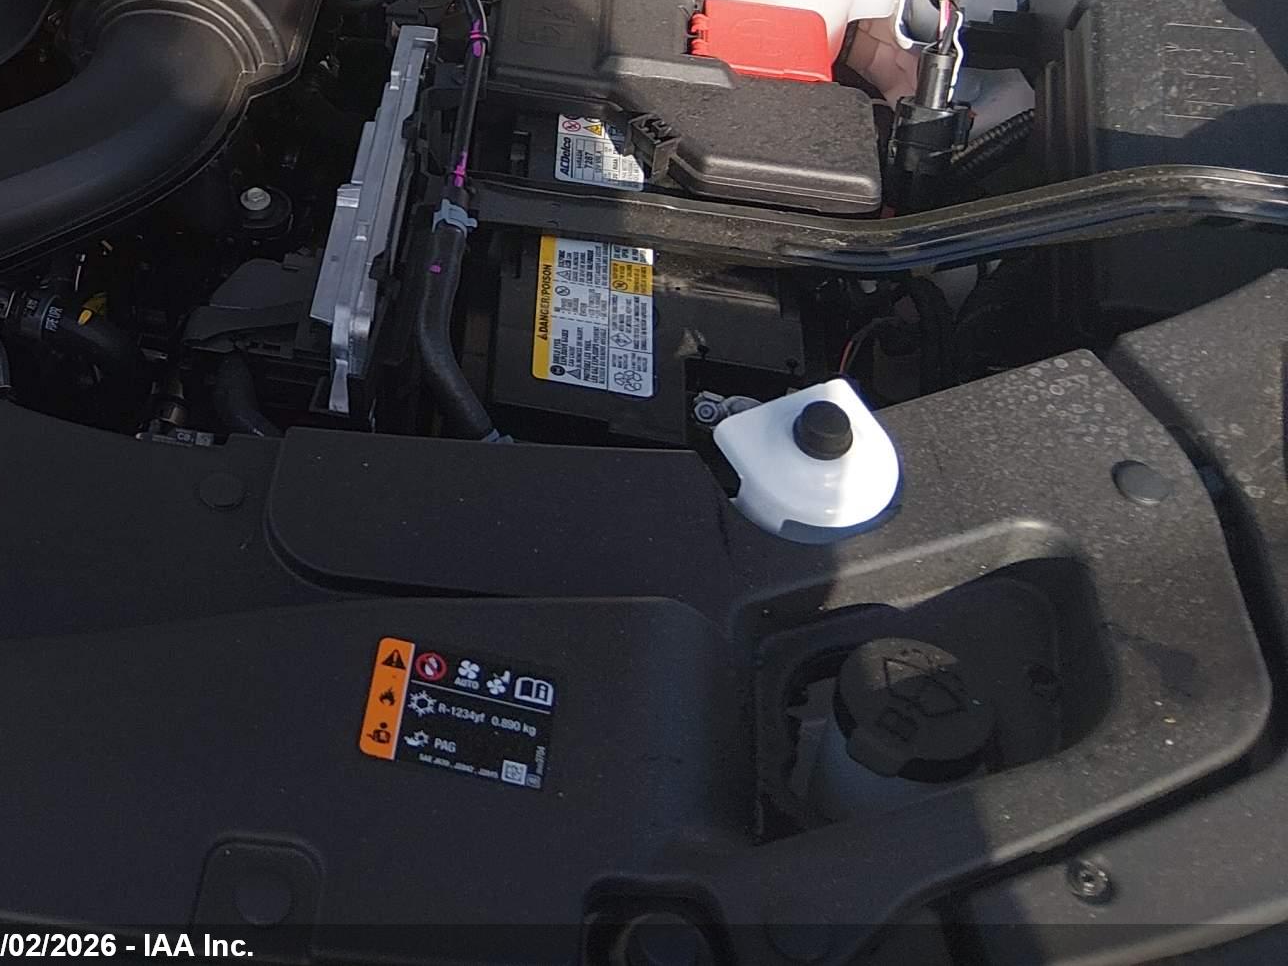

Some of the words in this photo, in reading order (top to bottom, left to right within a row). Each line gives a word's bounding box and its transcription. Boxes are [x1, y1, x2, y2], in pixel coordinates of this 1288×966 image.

[560, 137, 571, 176] ACDelco
[538, 264, 552, 333] DANGER/POISON
[454, 677, 480, 690] AUTO
[522, 722, 537, 738] kg
[434, 737, 457, 753] PAG
